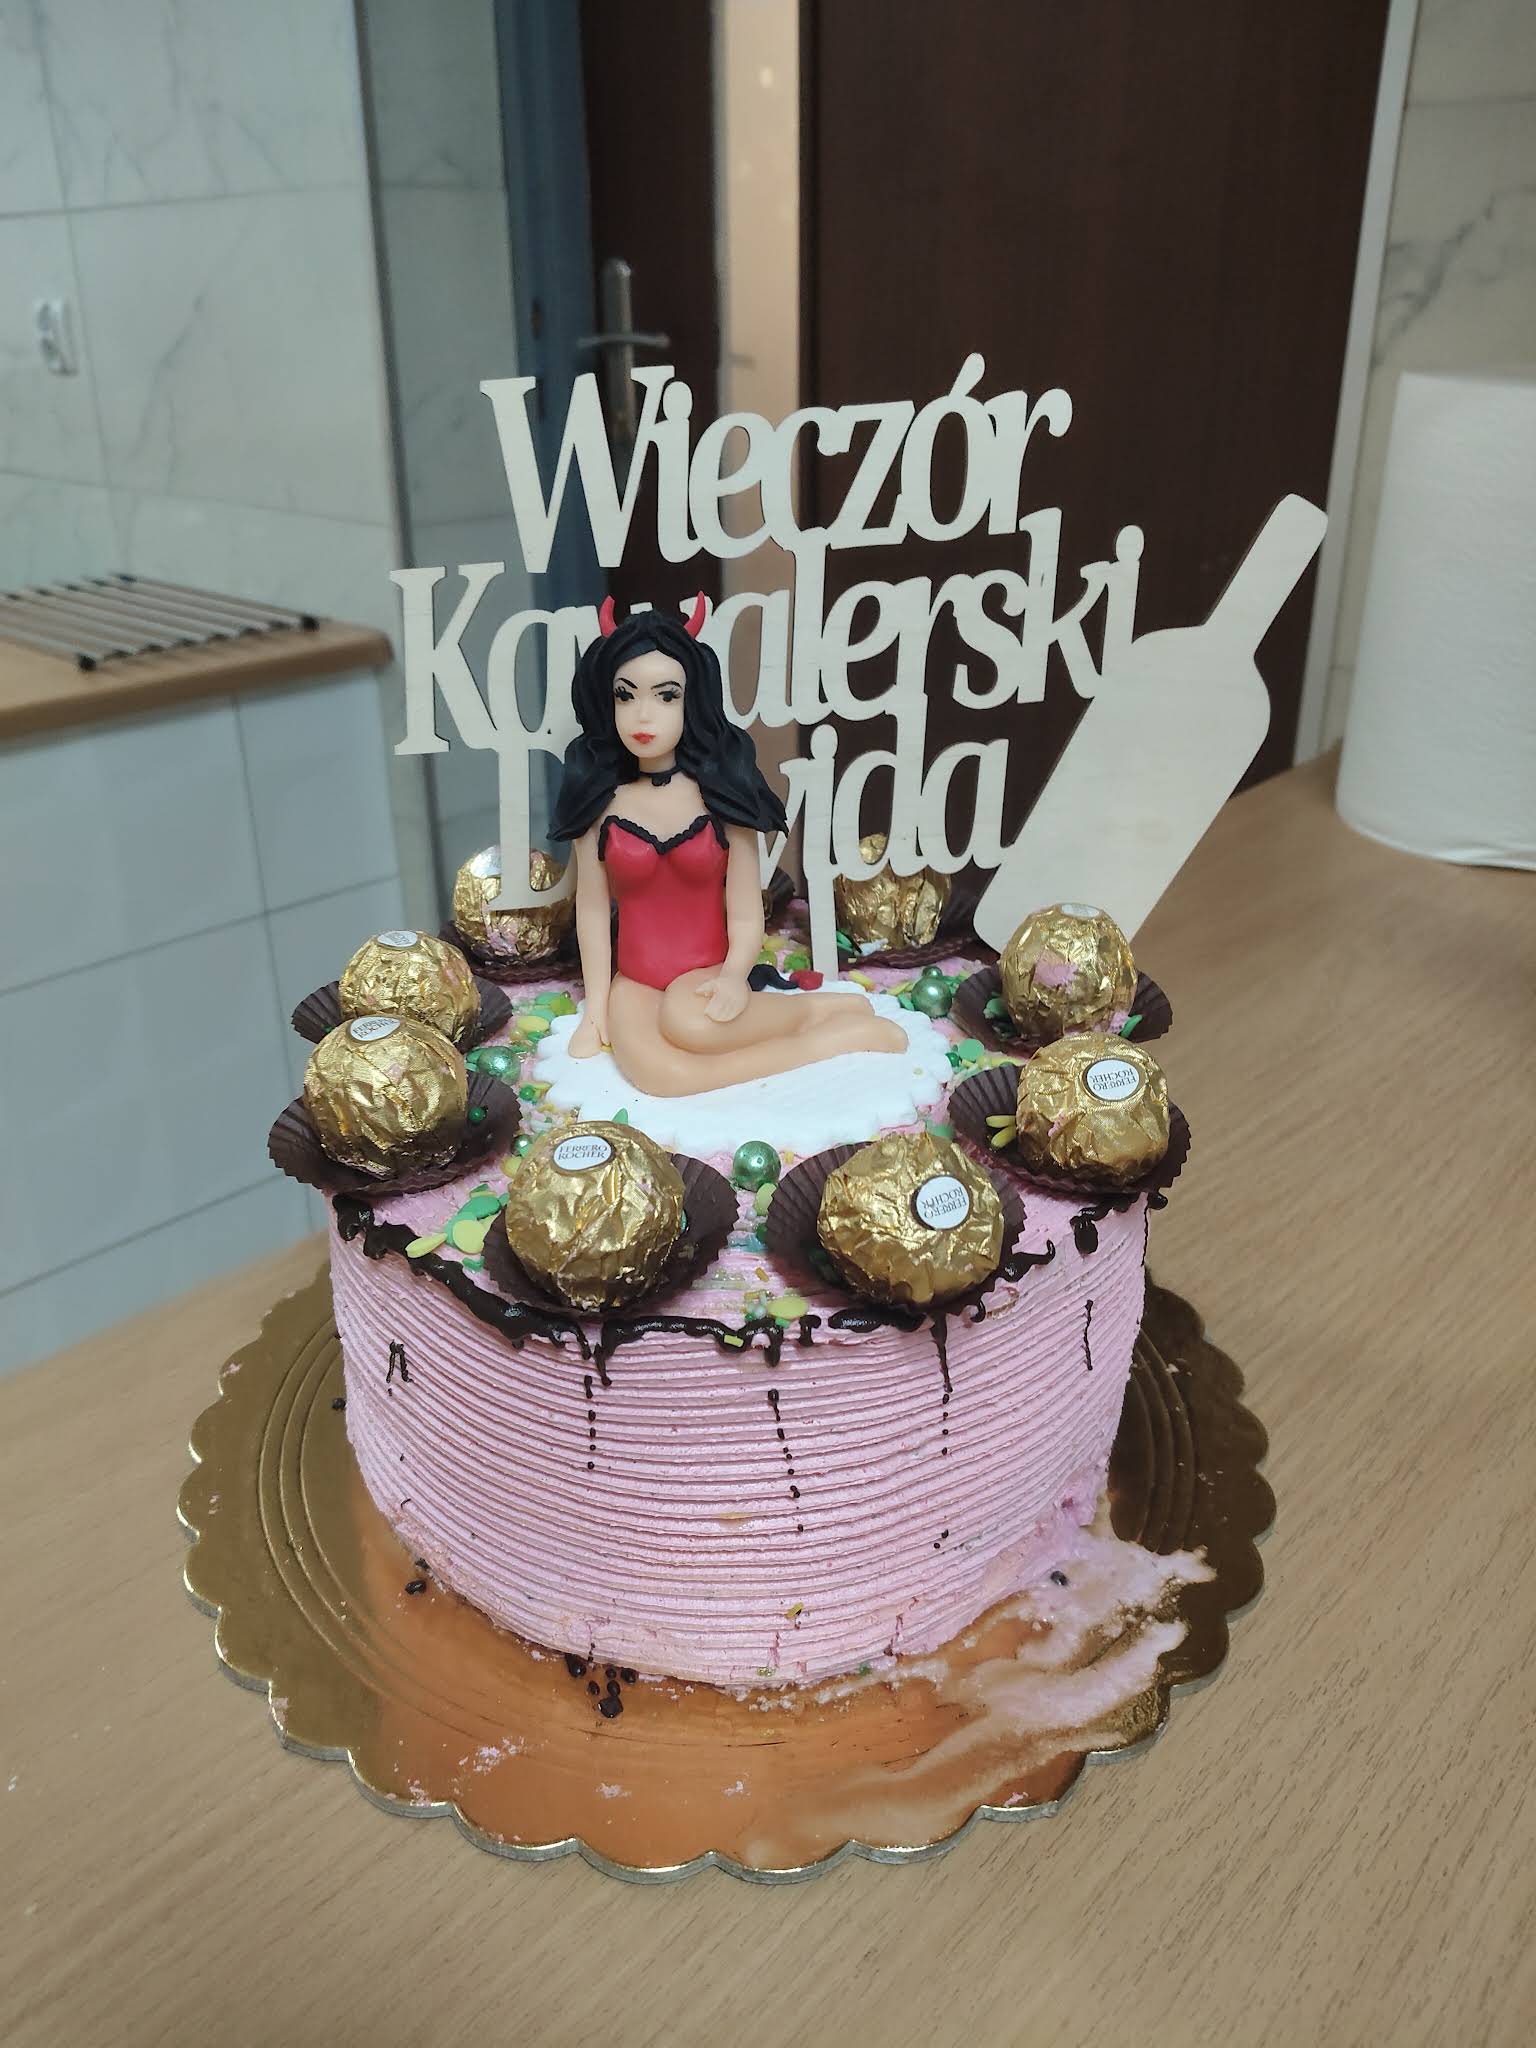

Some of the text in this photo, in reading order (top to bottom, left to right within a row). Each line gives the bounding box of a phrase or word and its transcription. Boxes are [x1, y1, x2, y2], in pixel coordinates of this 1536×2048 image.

[480, 353, 1072, 574] Wieczór
[389, 507, 1144, 756] Kaalerski
[1089, 1068, 1134, 1083] ROCHER
[1092, 1075, 1137, 1091] FERRERO
[558, 1151, 605, 1160] ROCHER
[559, 1144, 607, 1152] FERRERO
[920, 1186, 964, 1209] ROCHER
[924, 1196, 967, 1218] FERRERO
